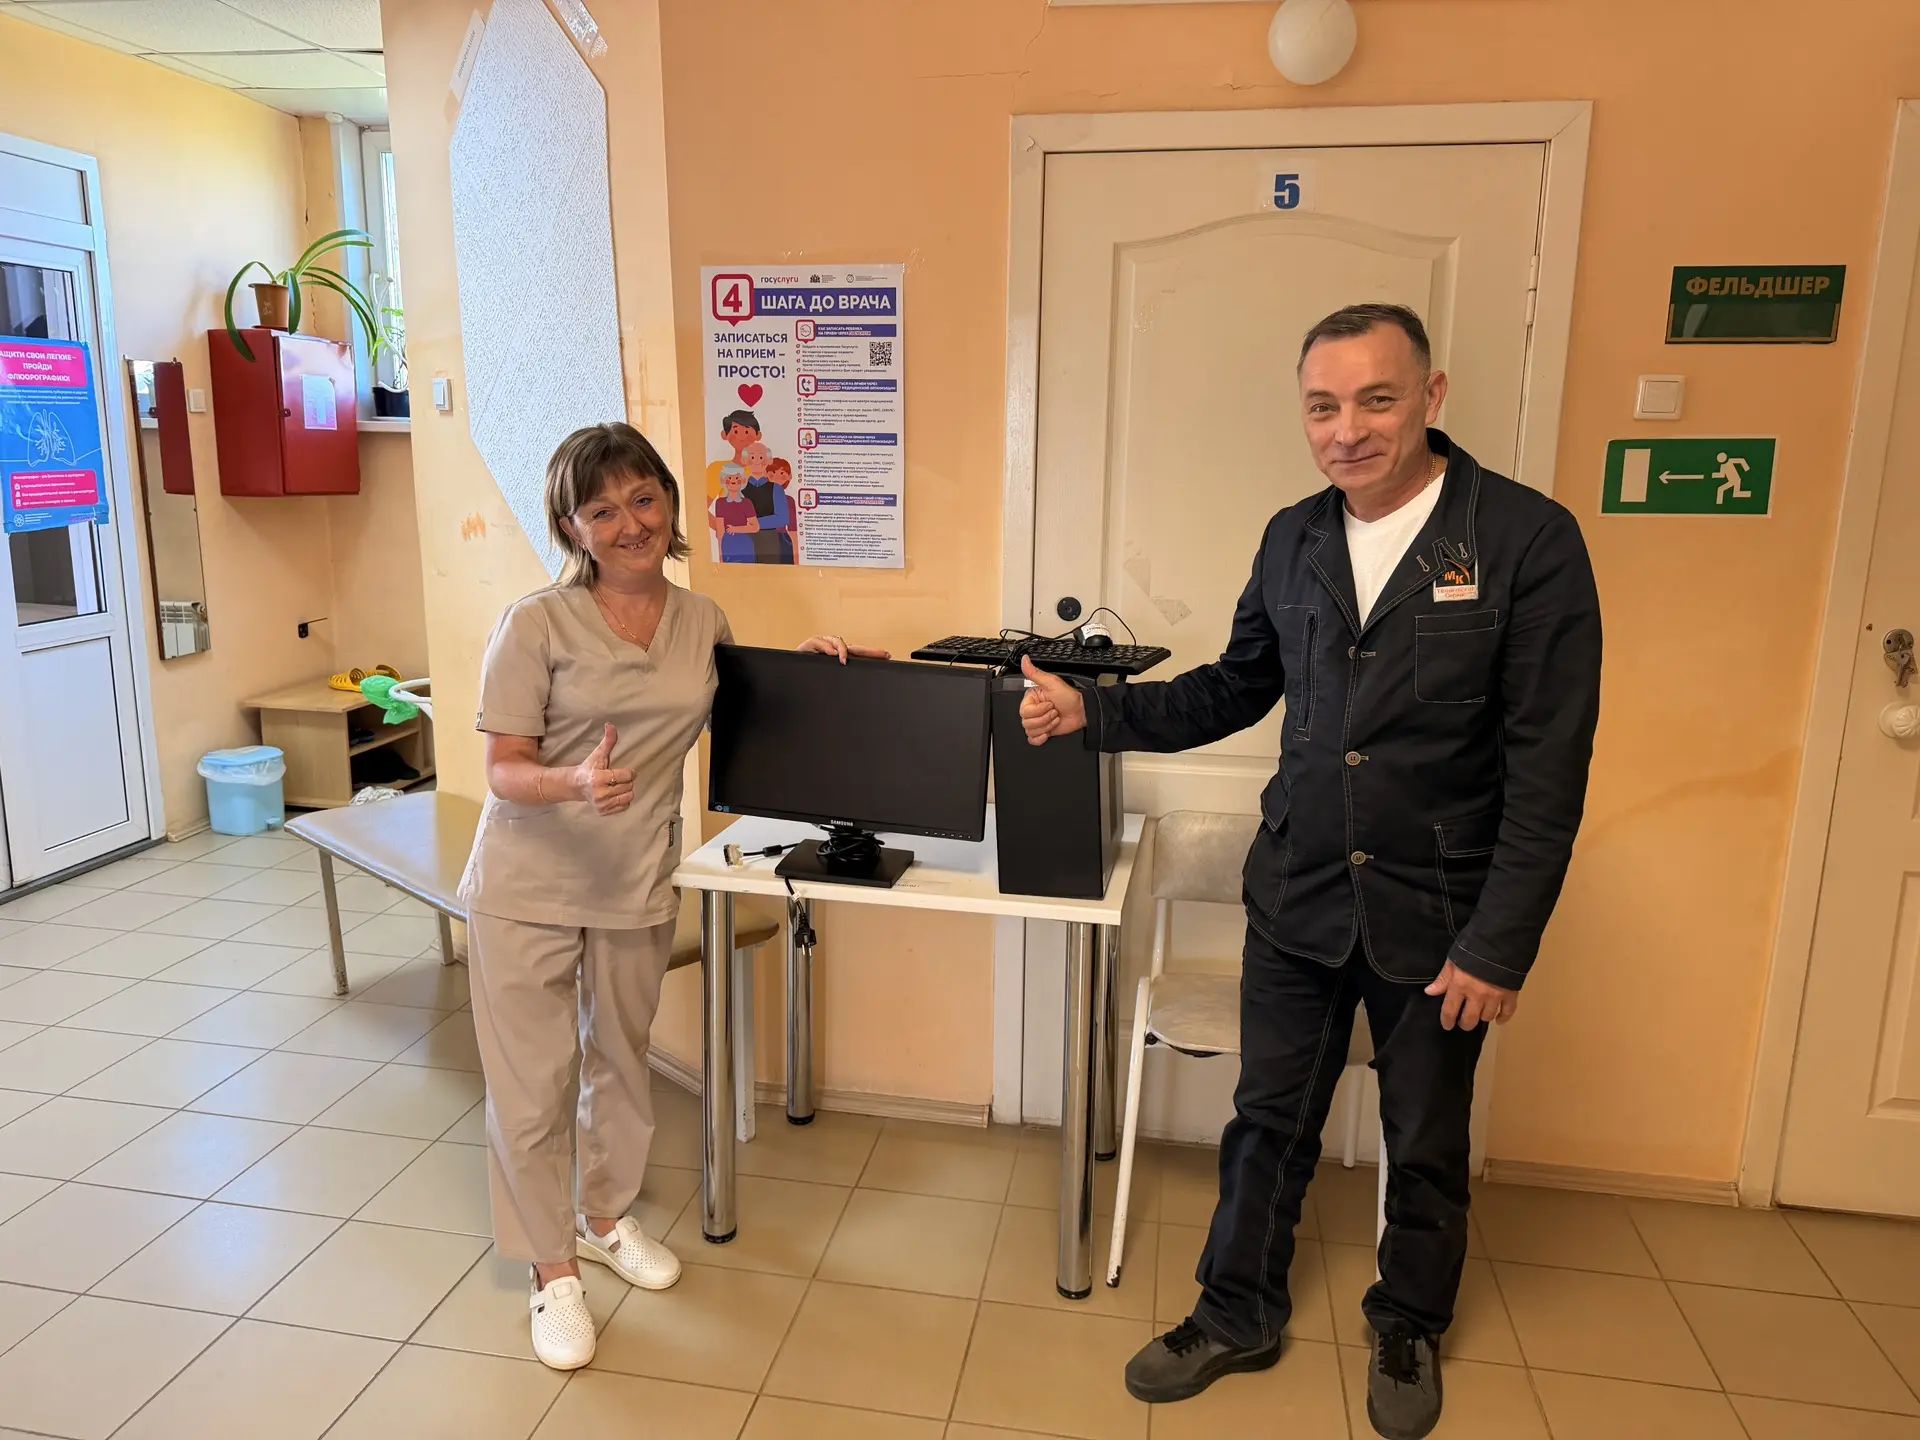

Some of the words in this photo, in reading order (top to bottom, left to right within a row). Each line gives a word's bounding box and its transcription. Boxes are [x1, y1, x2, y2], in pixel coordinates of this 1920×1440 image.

[1273, 173, 1300, 210] 5
[760, 274, 799, 285] госуслуги
[1685, 275, 1831, 299] ФЕЛЬДШЕР
[722, 283, 743, 313] 4
[761, 295, 806, 310] ШАГА
[809, 295, 835, 313] ДО
[839, 294, 891, 310] ВРАЧА
[713, 333, 788, 344] ЗАПИСАТЬСЯ
[26, 351, 46, 360] СВОИ
[47, 352, 72, 361] ЛЕГКИЕ
[717, 349, 734, 358] НА
[736, 348, 776, 359] ПРИЕМ
[22, 362, 53, 371] ПРОЙДИ
[718, 365, 786, 379] ПРОСТО!
[830, 819, 854, 827] SAMSUNG
